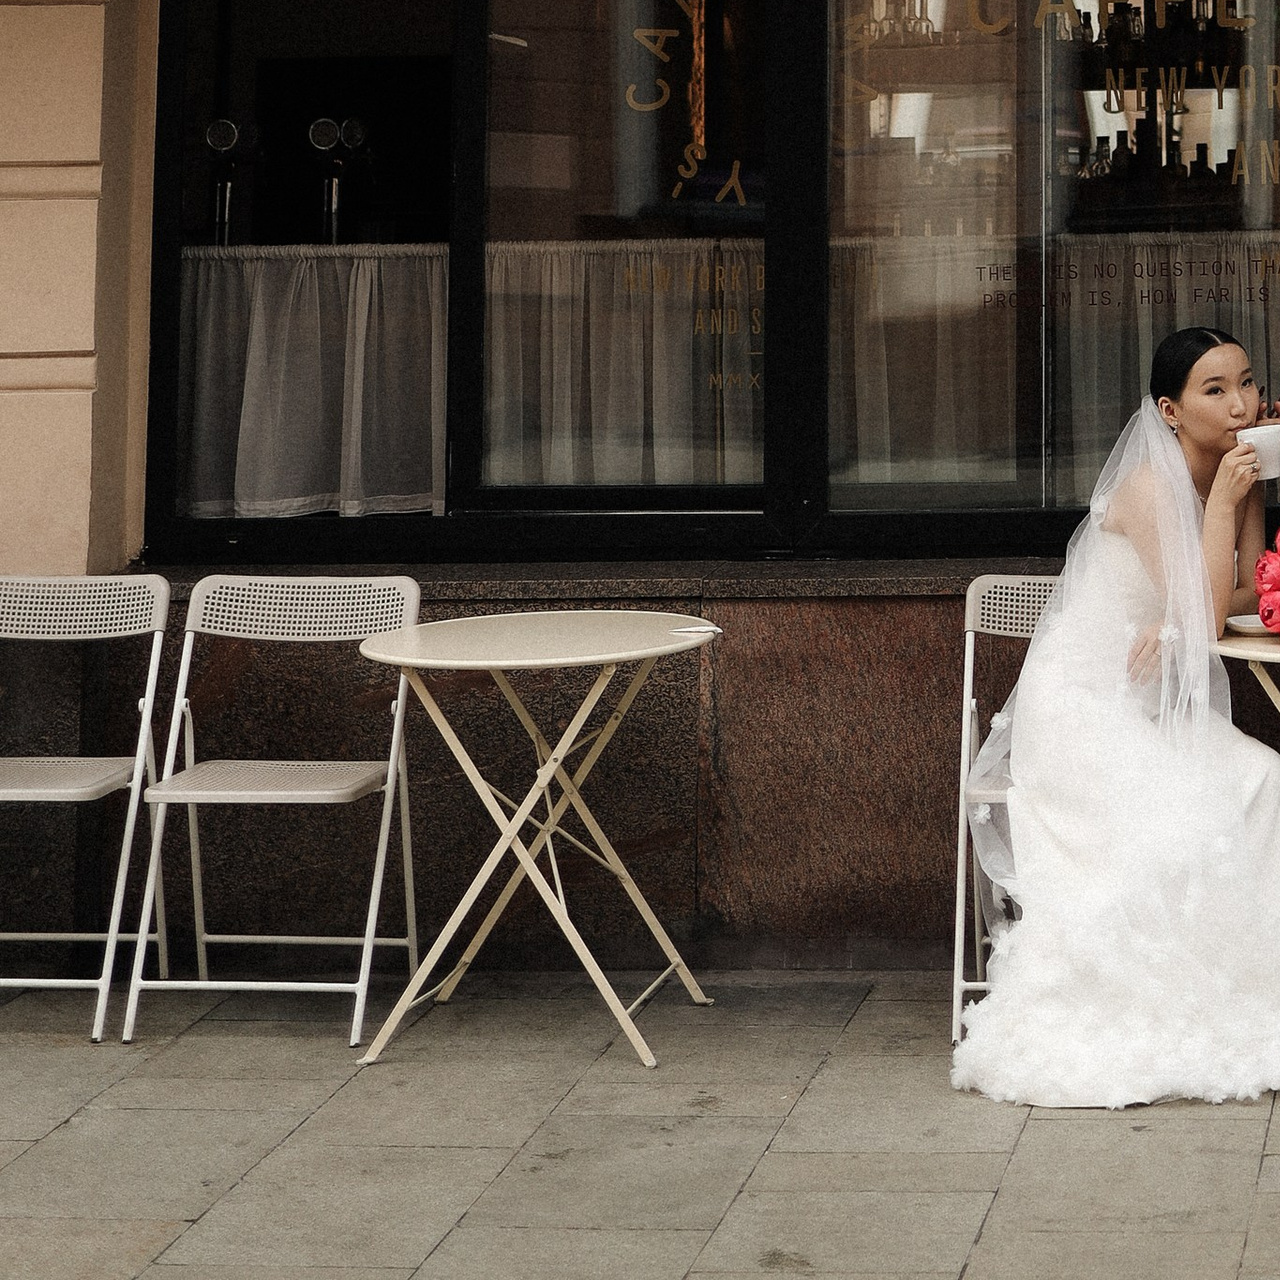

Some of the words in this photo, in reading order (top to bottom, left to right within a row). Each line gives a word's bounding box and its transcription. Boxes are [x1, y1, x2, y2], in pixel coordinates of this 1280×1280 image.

[1105, 66, 1188, 112] NEW
[1055, 263, 1079, 280] IS
[1093, 262, 1118, 280] NO
[1132, 260, 1236, 280] QUESTION
[1087, 290, 1123, 308] IS,
[1139, 289, 1178, 306] HOW
[1193, 287, 1230, 304] FAR
[1245, 286, 1270, 303] IS
